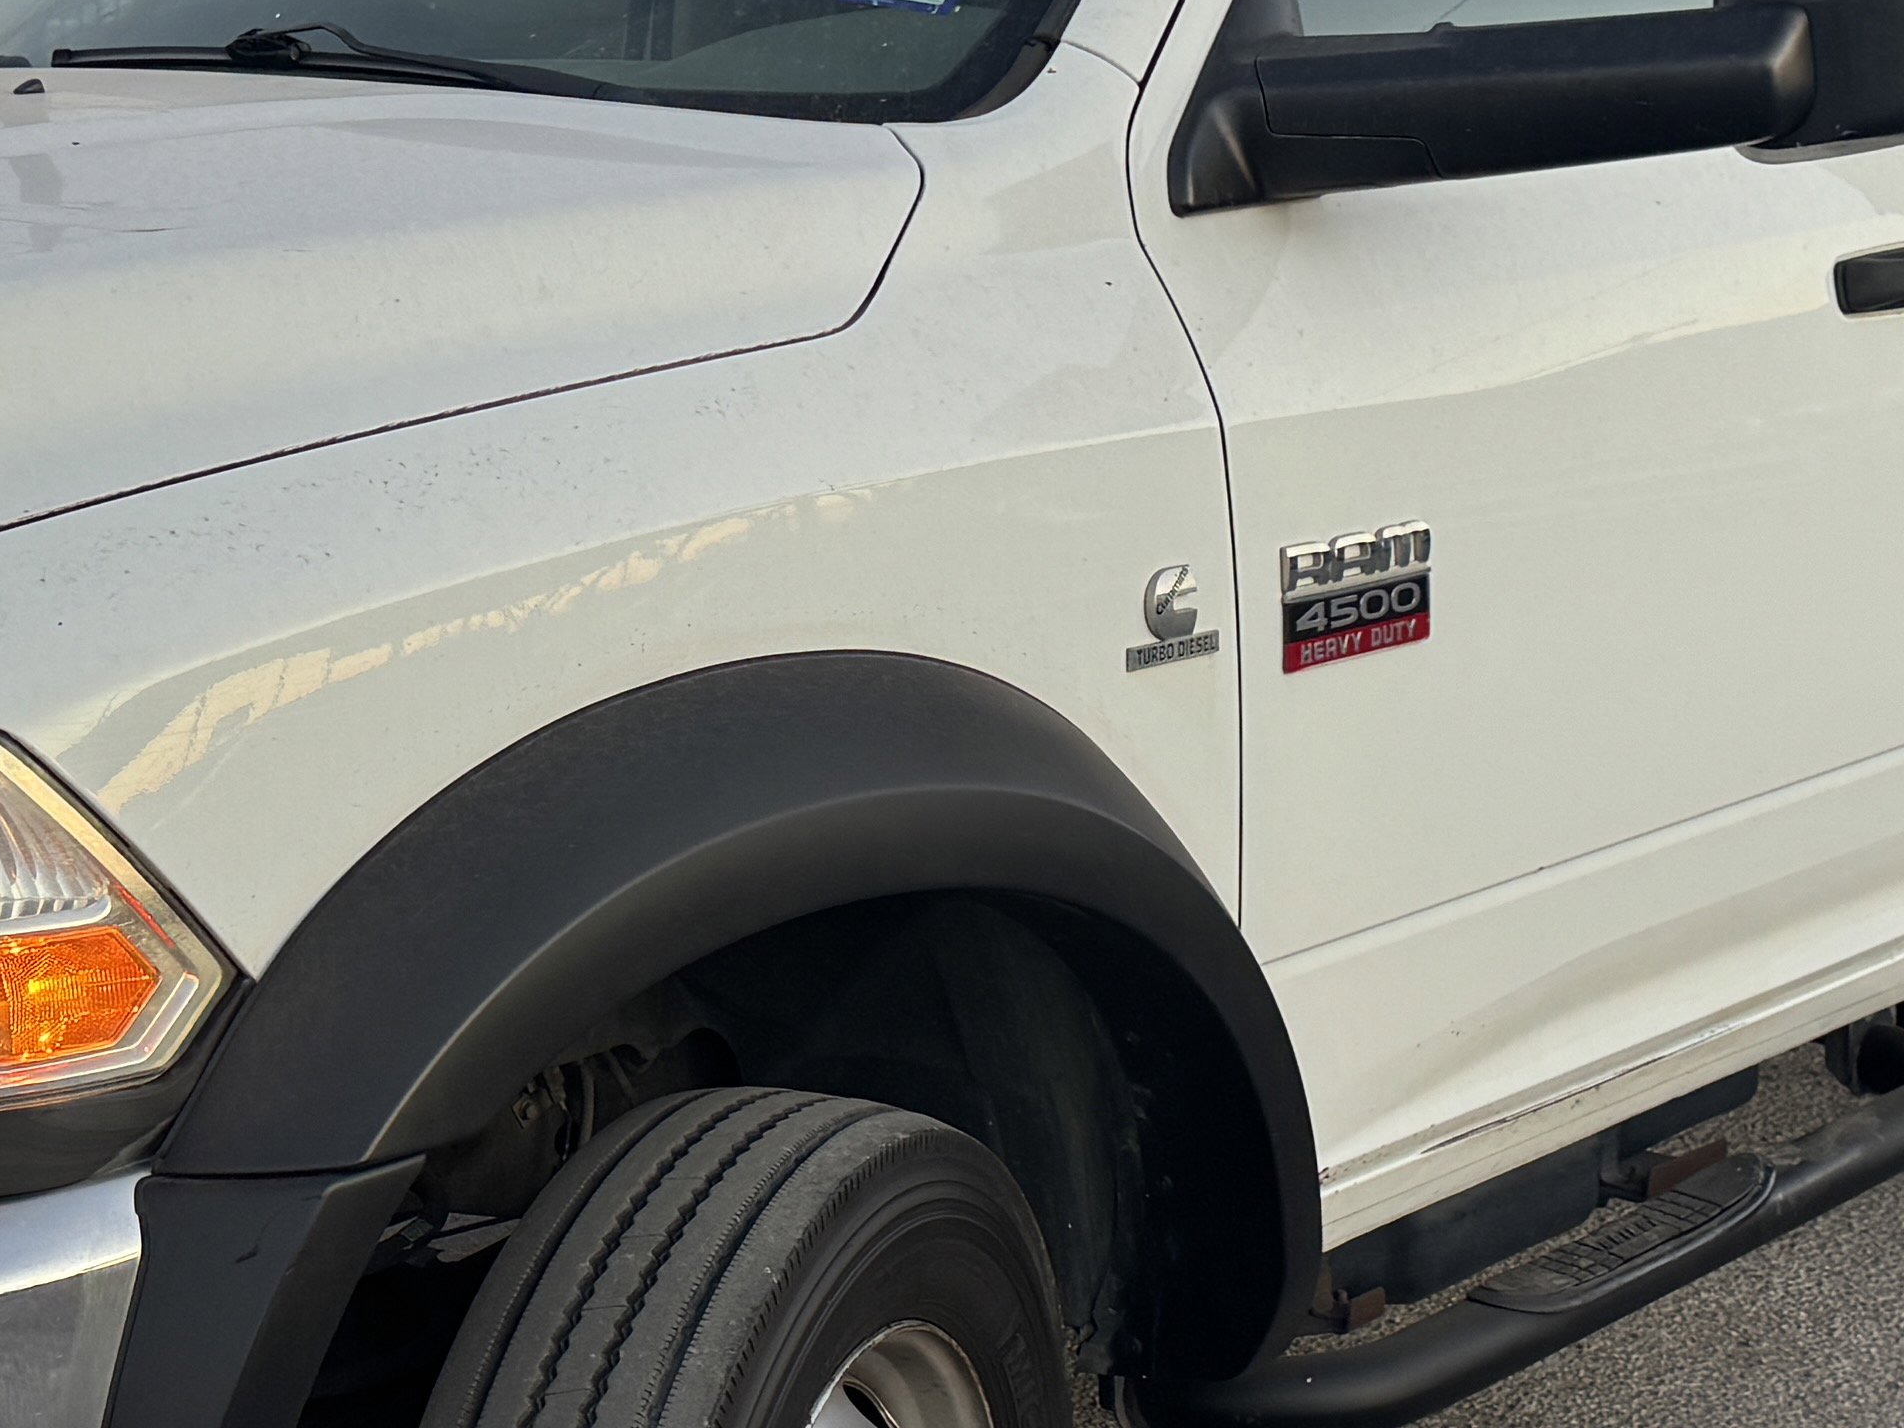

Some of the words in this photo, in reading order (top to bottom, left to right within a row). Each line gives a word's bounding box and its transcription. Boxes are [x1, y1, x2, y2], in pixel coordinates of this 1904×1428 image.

[1280, 520, 1430, 594] RAM
[1296, 582, 1421, 632] 4500
[1136, 643, 1175, 666] TURBO
[1177, 633, 1215, 658] DIESEL
[1300, 632, 1362, 664] HEAVY
[1371, 619, 1416, 647] DUTY
